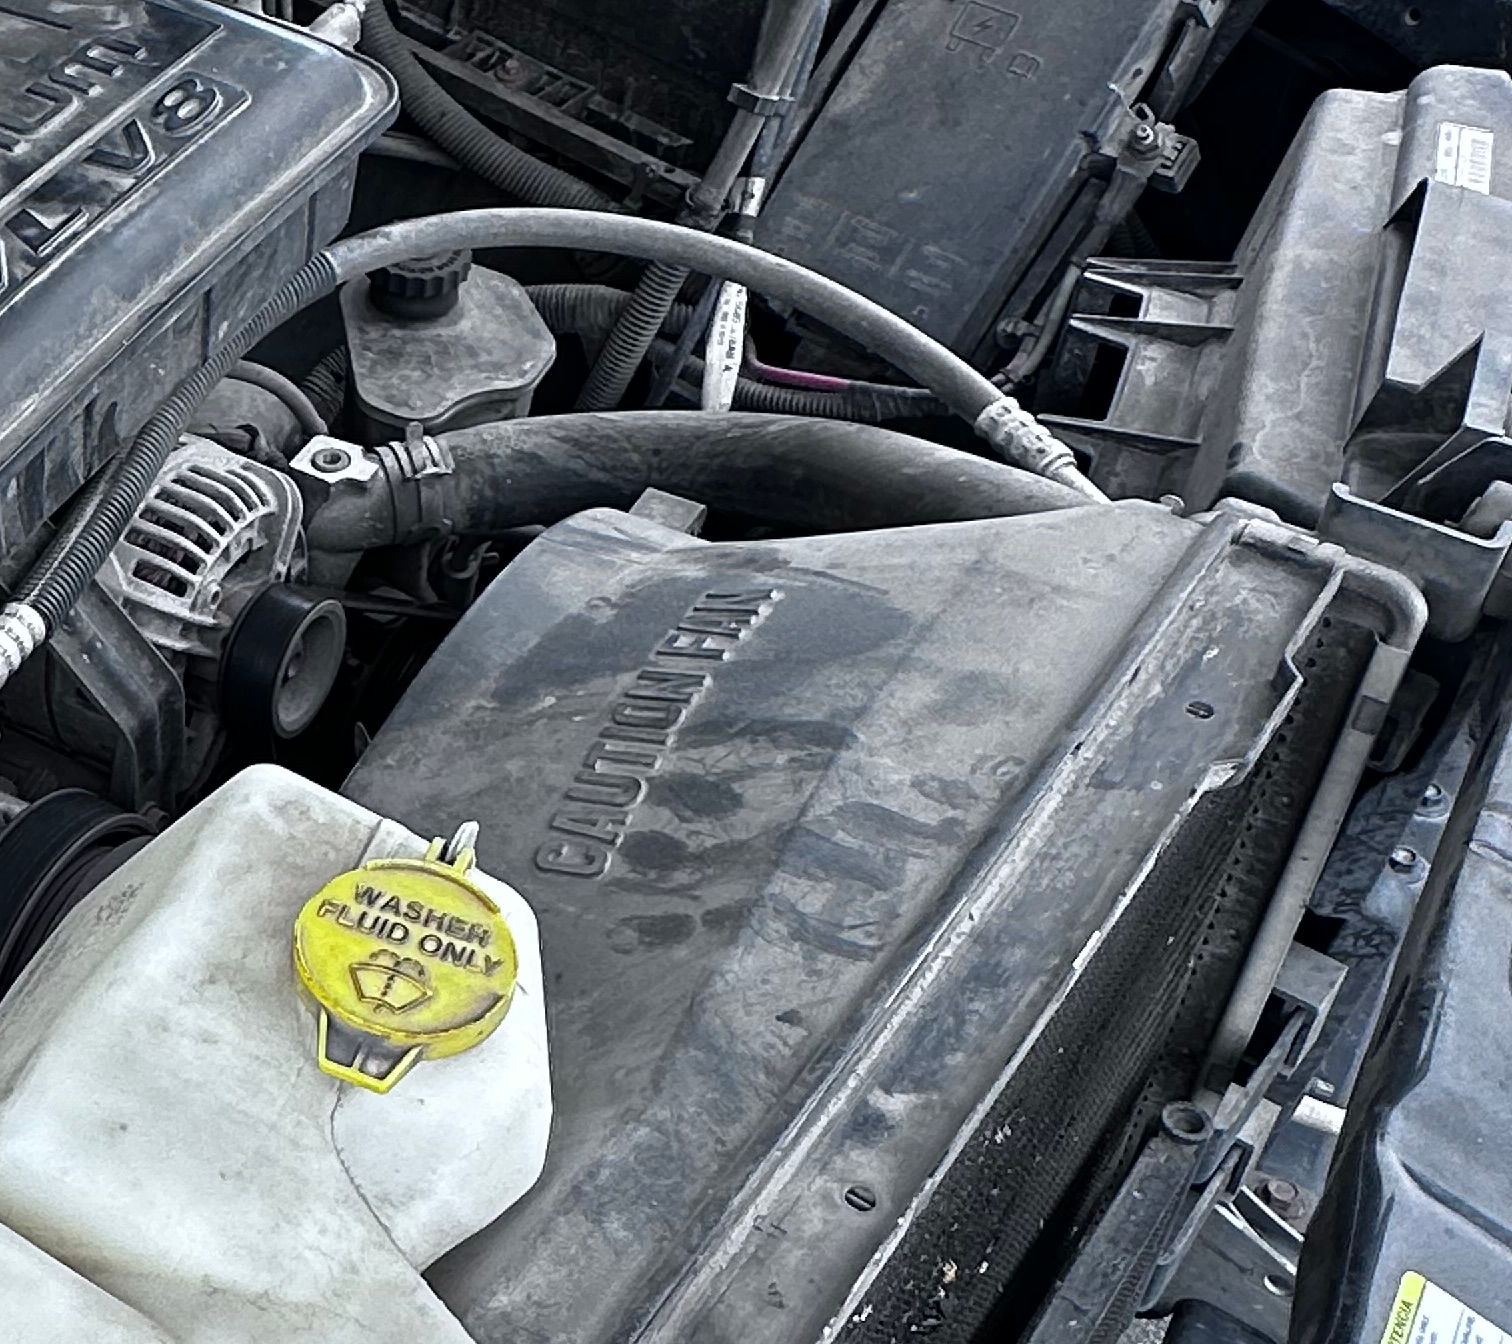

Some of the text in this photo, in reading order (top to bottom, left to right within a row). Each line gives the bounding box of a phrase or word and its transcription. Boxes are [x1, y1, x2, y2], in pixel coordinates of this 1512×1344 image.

[86, 75, 226, 179] V8
[534, 589, 786, 878] CAUTION FAN
[316, 898, 504, 976] FLUID ONLY
[354, 884, 491, 947] WASHER
